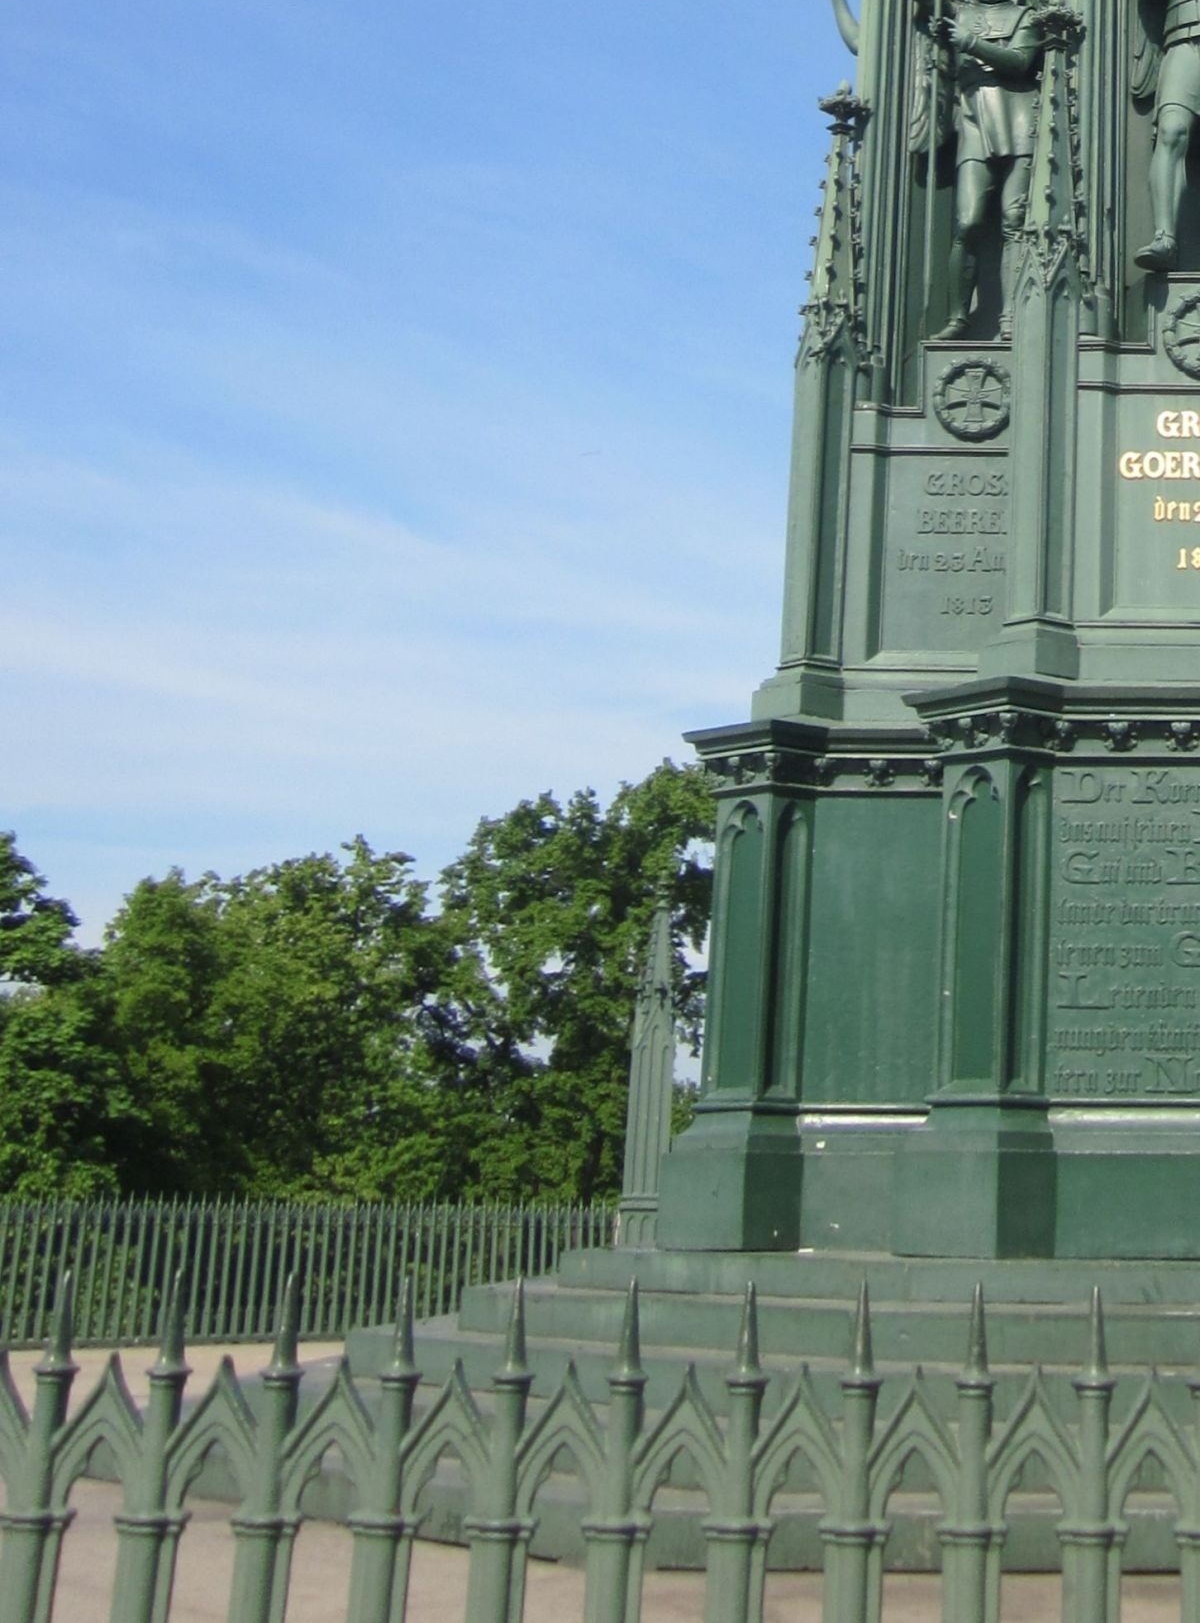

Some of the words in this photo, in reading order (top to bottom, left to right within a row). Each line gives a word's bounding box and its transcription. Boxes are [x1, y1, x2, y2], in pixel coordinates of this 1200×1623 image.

[1154, 496, 1191, 521] den
[941, 597, 992, 615] 1813
[1060, 771, 1126, 803] Der
[1061, 849, 1121, 885] Gut
